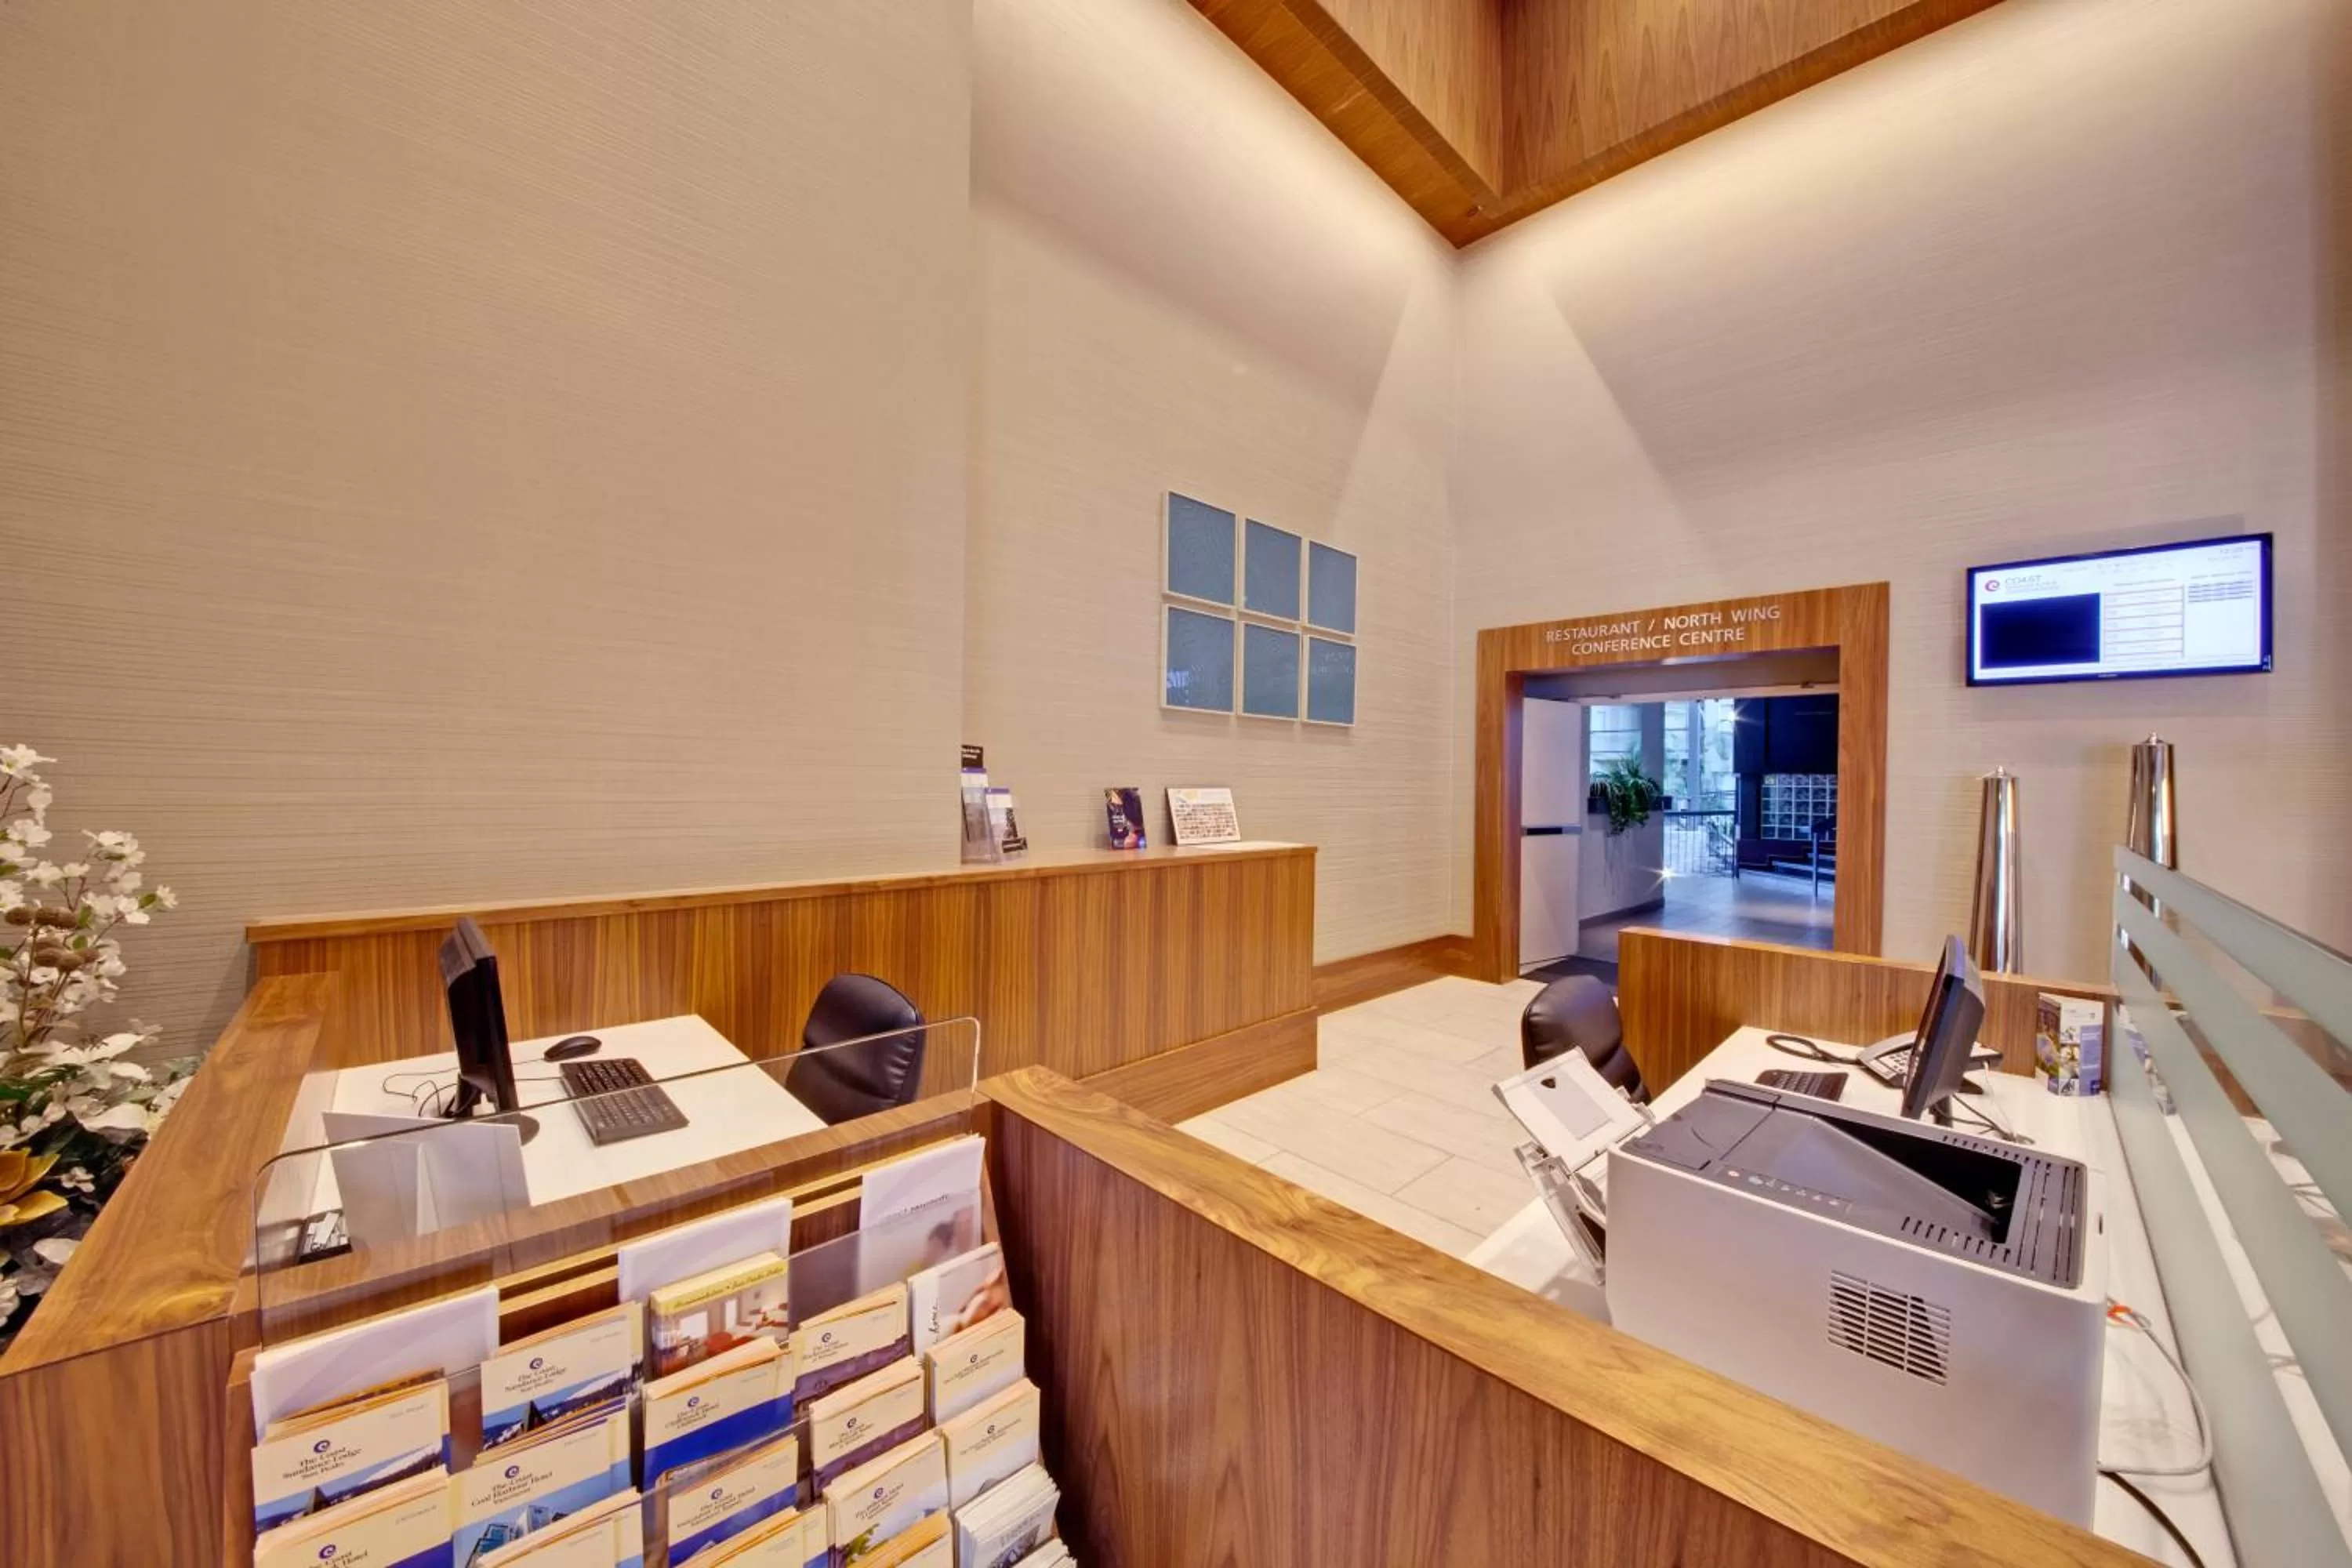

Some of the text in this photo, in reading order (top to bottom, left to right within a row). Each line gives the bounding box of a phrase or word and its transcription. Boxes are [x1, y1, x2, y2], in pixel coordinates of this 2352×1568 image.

[1546, 605, 1780, 643] RESTAURANT / NORTH WING
[1571, 627, 1745, 655] CONFERENCE CENTRE
